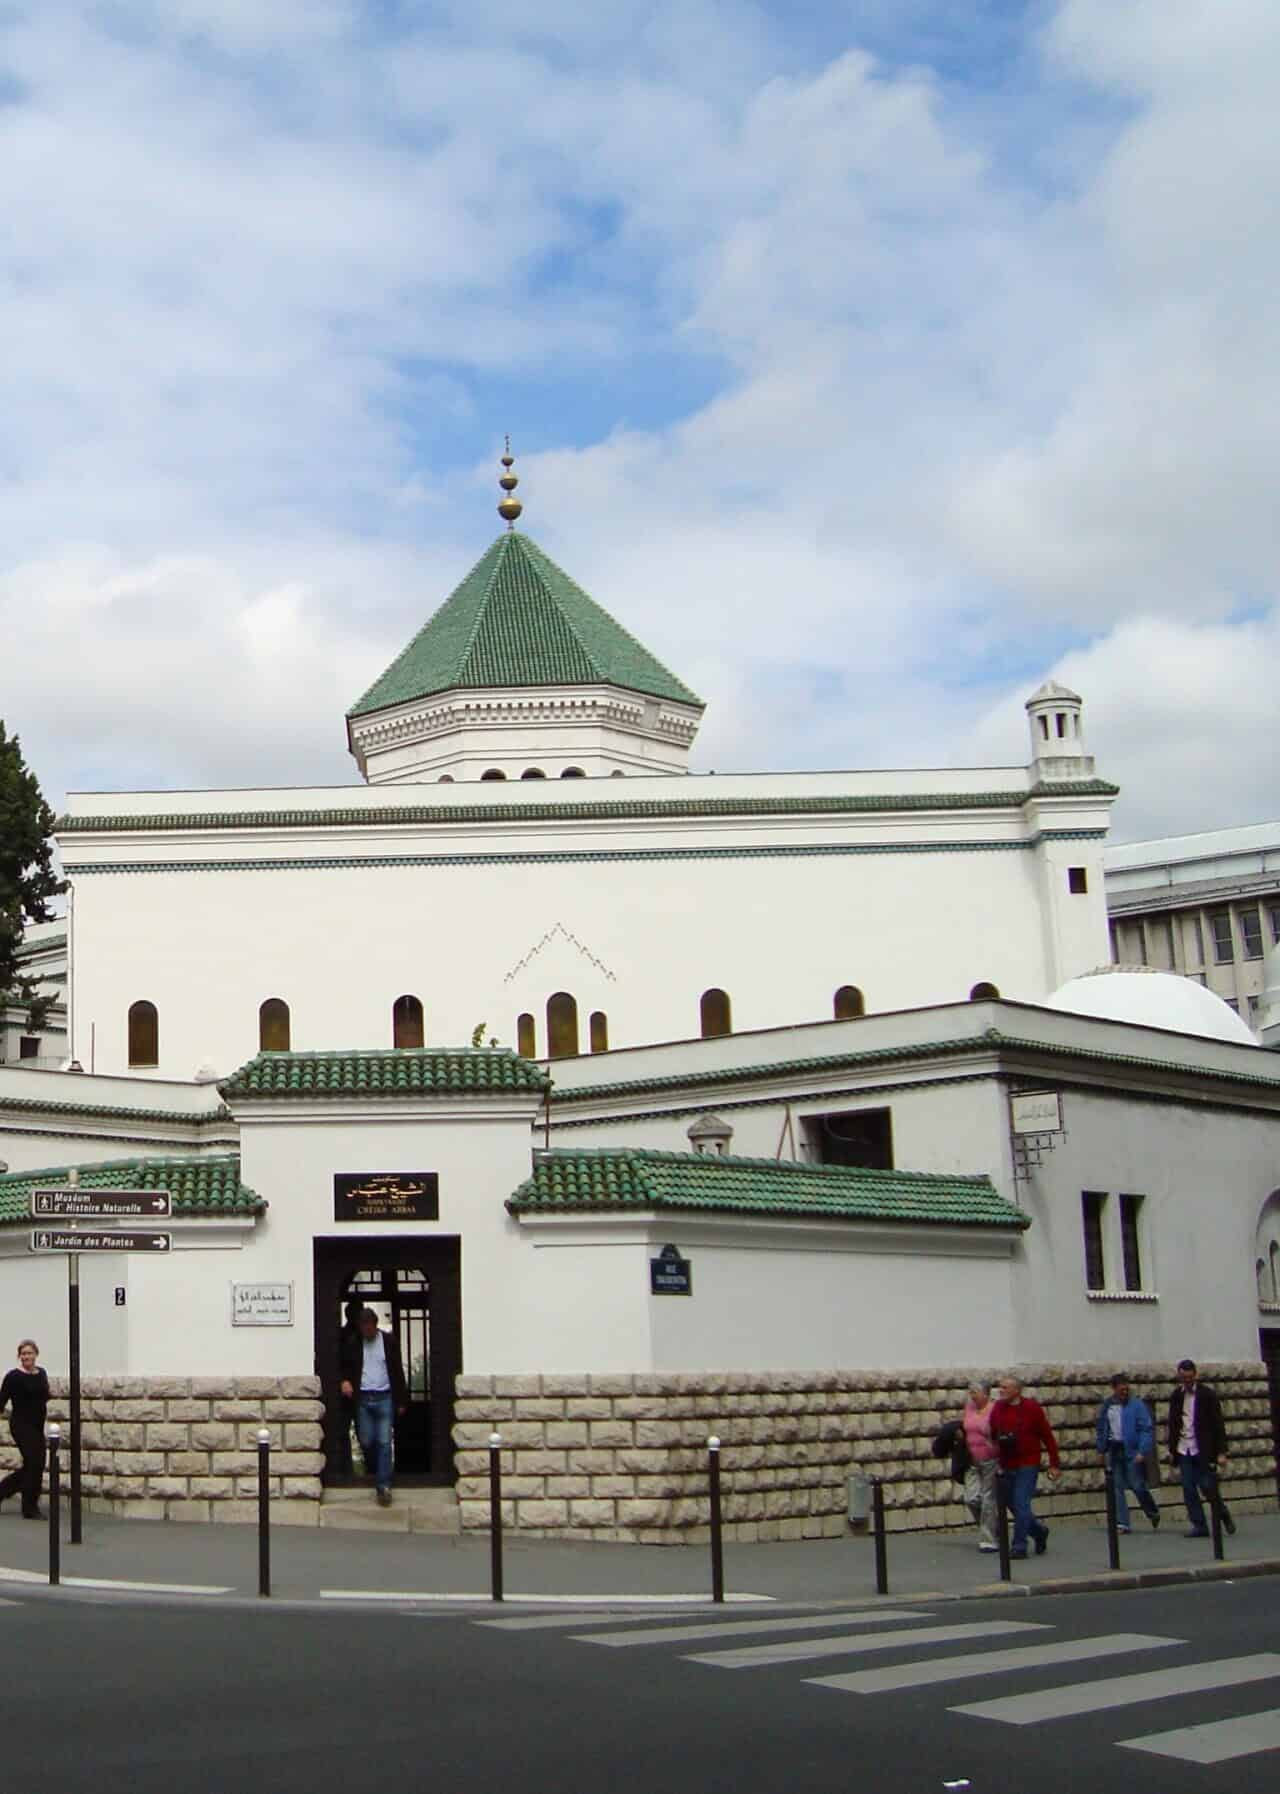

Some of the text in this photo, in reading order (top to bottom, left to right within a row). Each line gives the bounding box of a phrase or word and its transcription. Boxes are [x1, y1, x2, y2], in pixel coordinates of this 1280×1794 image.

[54, 1192, 91, 1202] Muséum
[66, 1203, 100, 1213] Histoire
[102, 1203, 141, 1213] Naturelle
[54, 1235, 134, 1247] Jardin des Plantes
